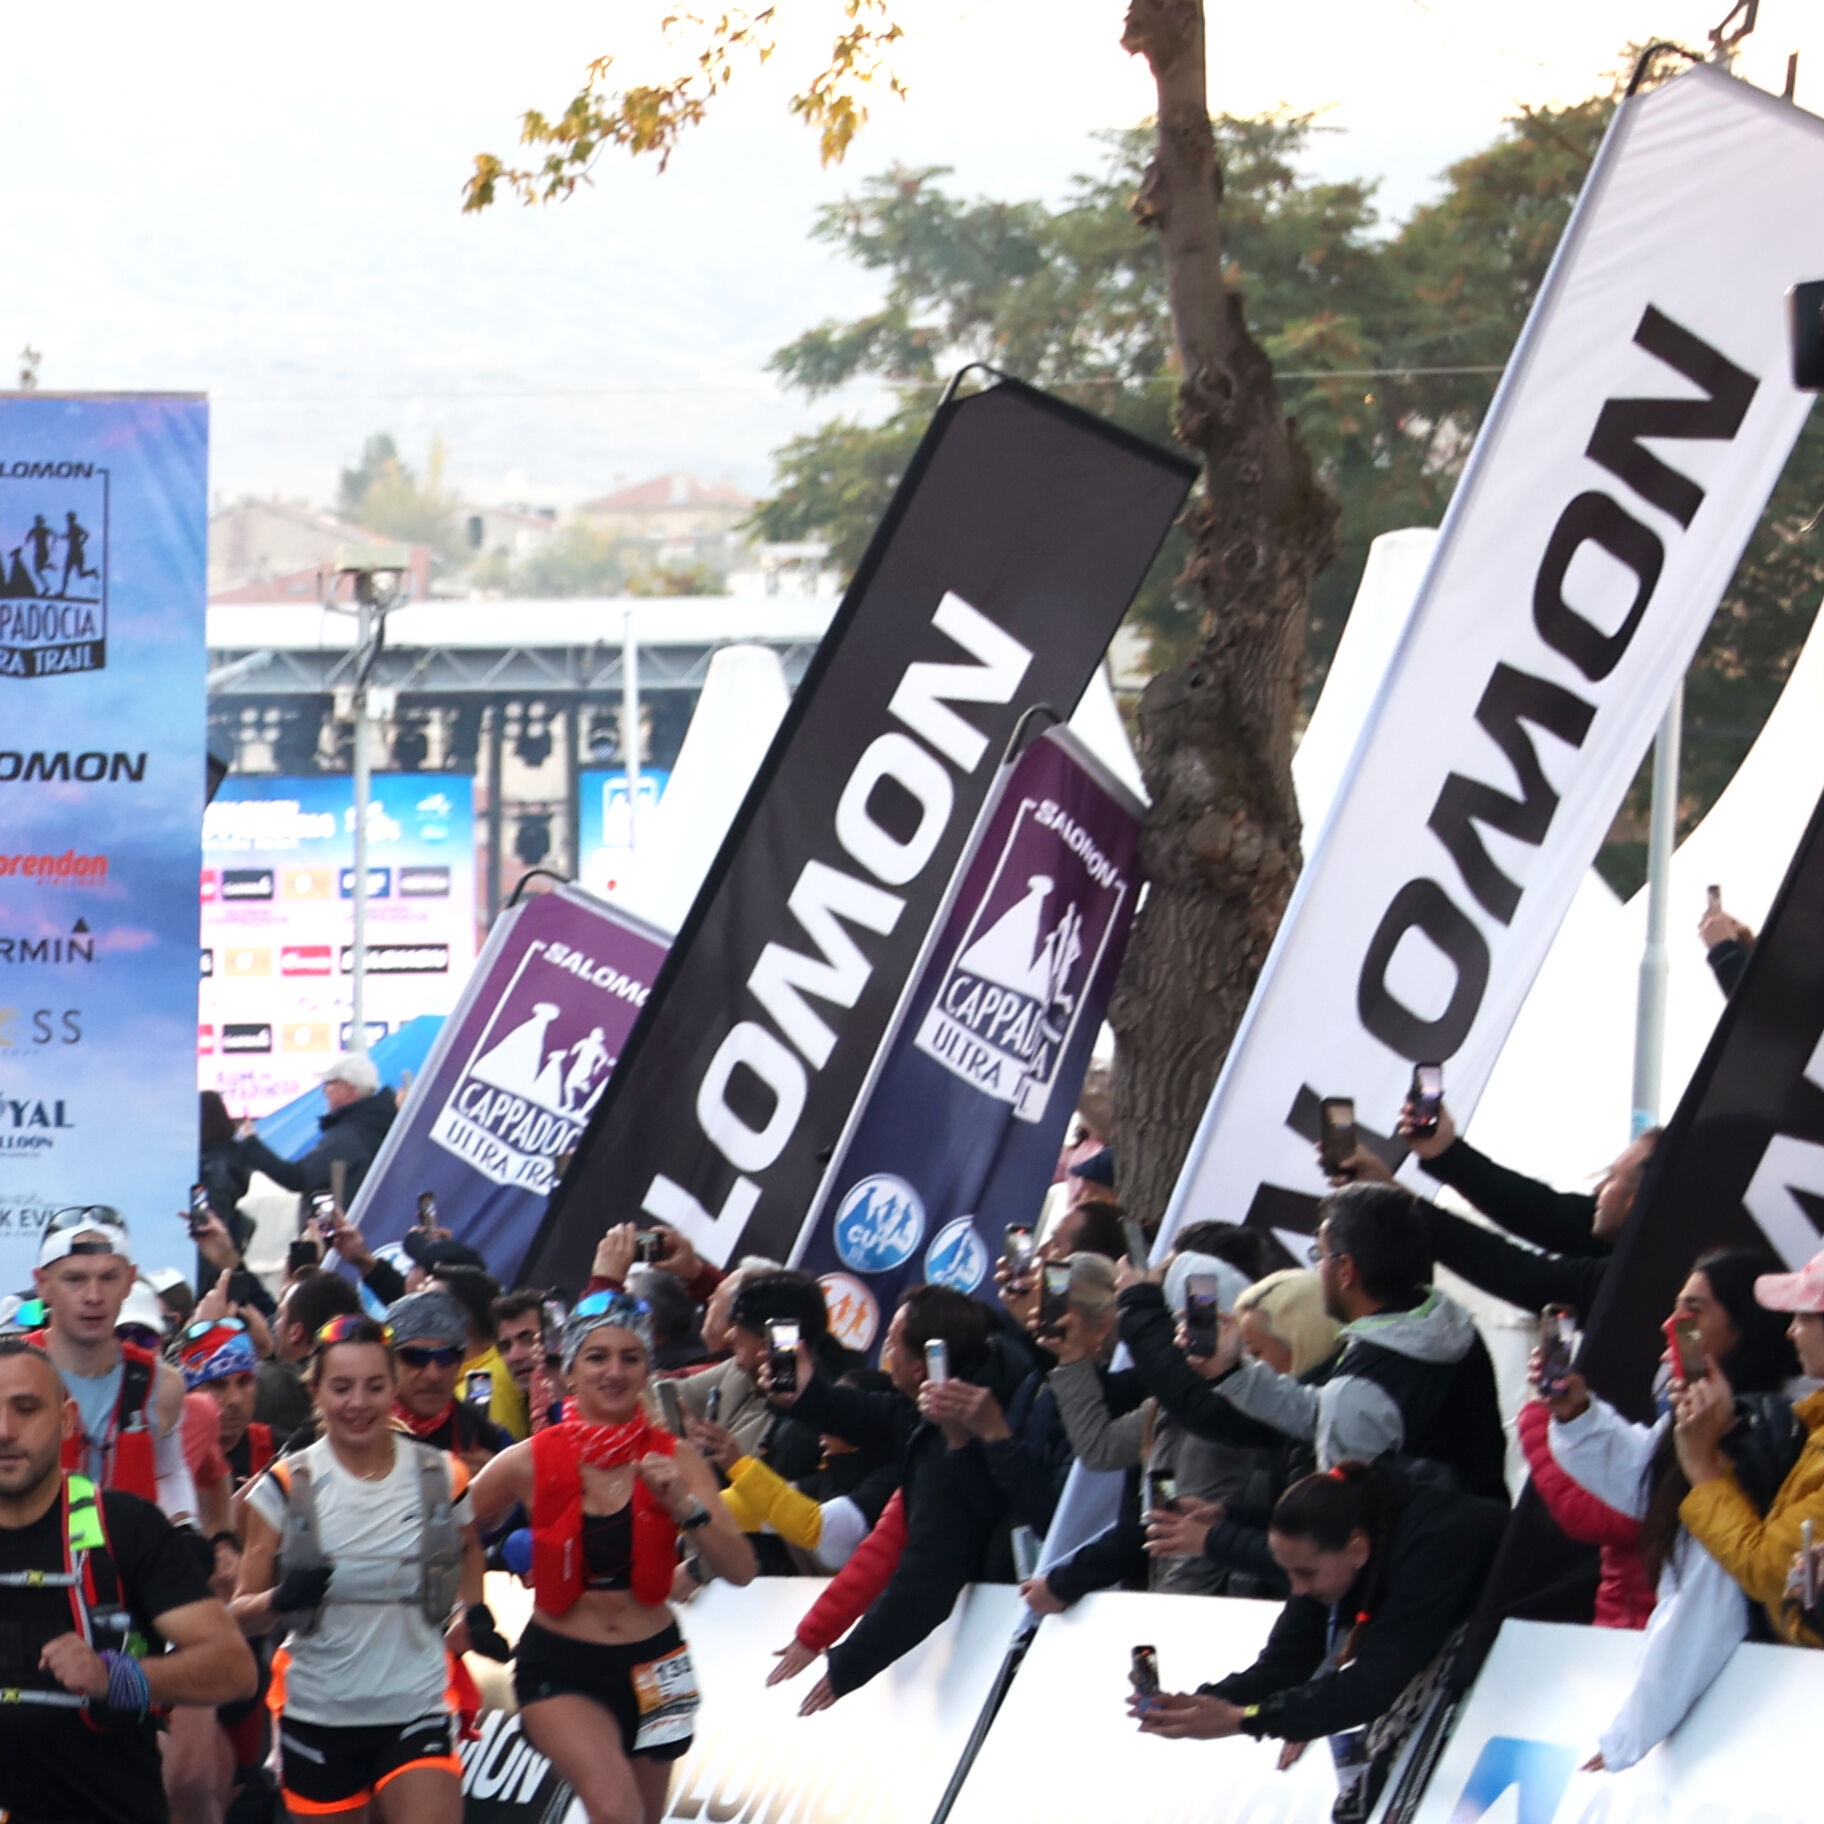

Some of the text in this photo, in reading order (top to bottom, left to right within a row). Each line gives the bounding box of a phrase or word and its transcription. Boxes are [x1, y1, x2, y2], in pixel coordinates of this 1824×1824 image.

[34, 645, 95, 673] TRAIL
[640, 590, 1033, 1266] LOMON
[543, 942, 651, 1007] SALOM
[933, 1022, 1002, 1090] ULTRA
[447, 1120, 507, 1178] ULTRA
